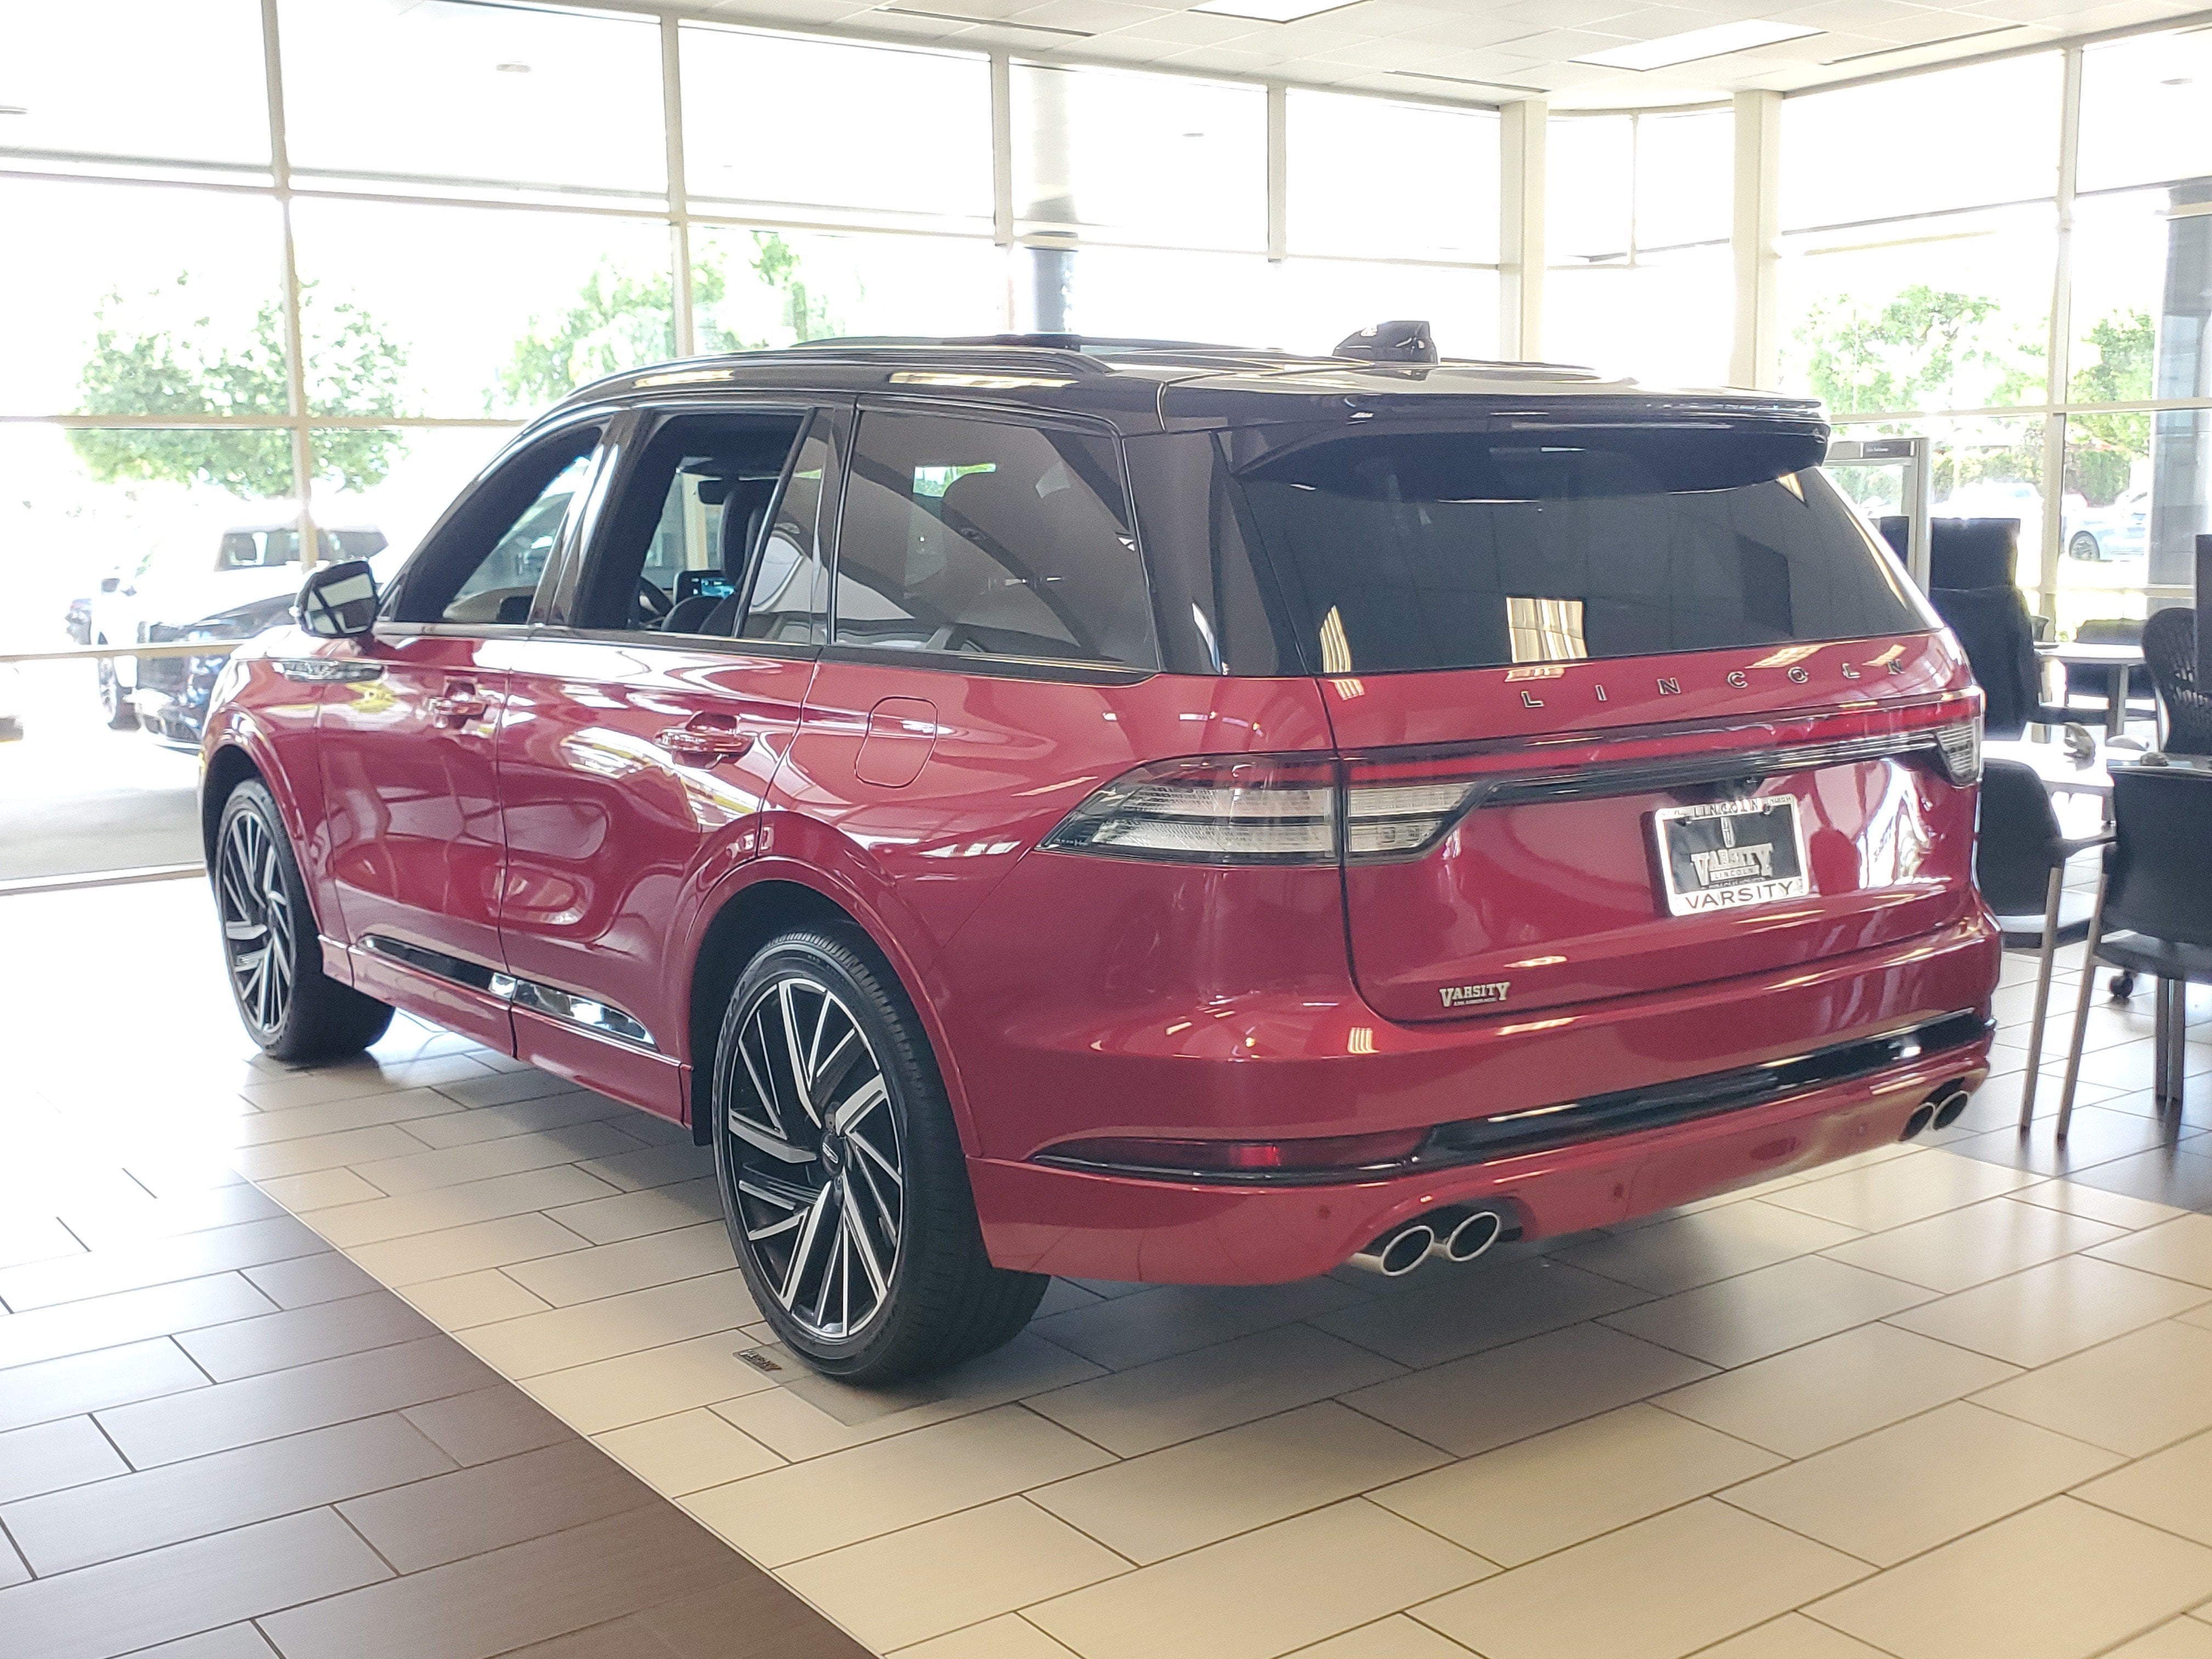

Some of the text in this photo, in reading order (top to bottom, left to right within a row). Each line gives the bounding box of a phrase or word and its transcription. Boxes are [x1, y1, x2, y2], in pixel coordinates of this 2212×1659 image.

[1521, 658, 1904, 708] LINCOLN
[1690, 843, 1773, 885] VARSITY
[1685, 881, 1793, 909] VARSITY
[1440, 982, 1510, 1007] VARSITY
